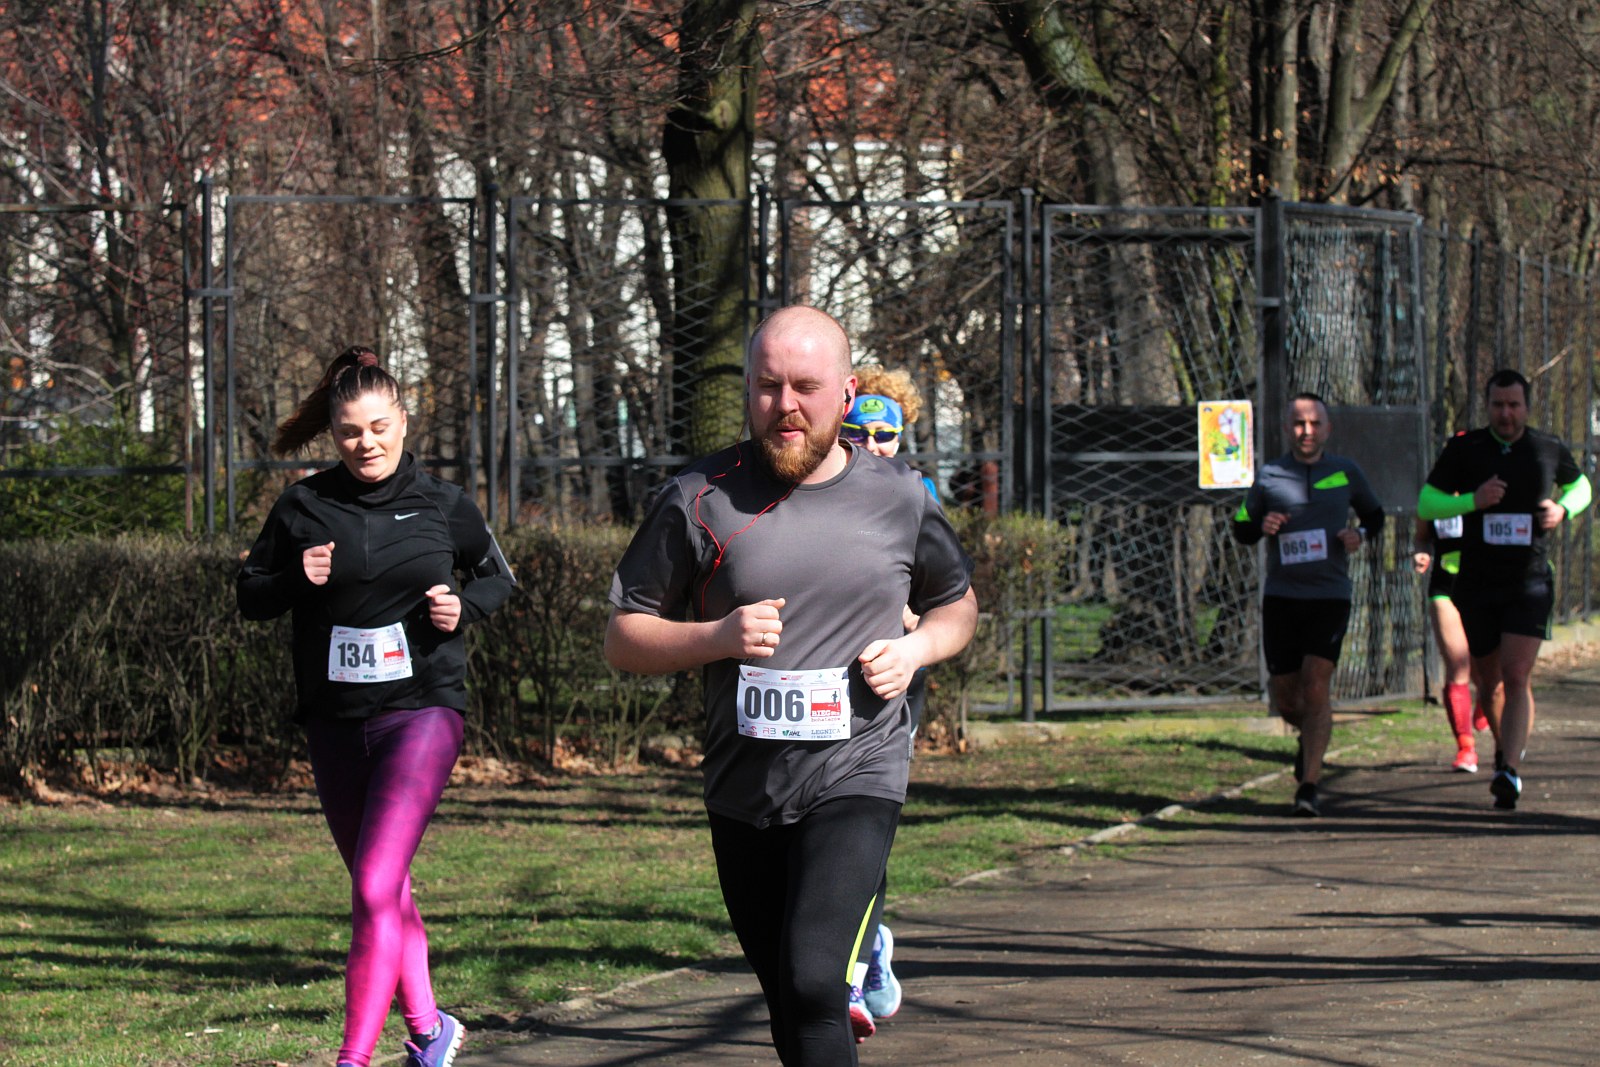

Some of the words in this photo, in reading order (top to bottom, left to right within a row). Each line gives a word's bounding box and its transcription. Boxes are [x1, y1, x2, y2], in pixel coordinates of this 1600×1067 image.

[1488, 522, 1512, 537] 105
[1282, 539, 1308, 557] 069
[337, 642, 377, 669] 134
[744, 685, 805, 722] 006
